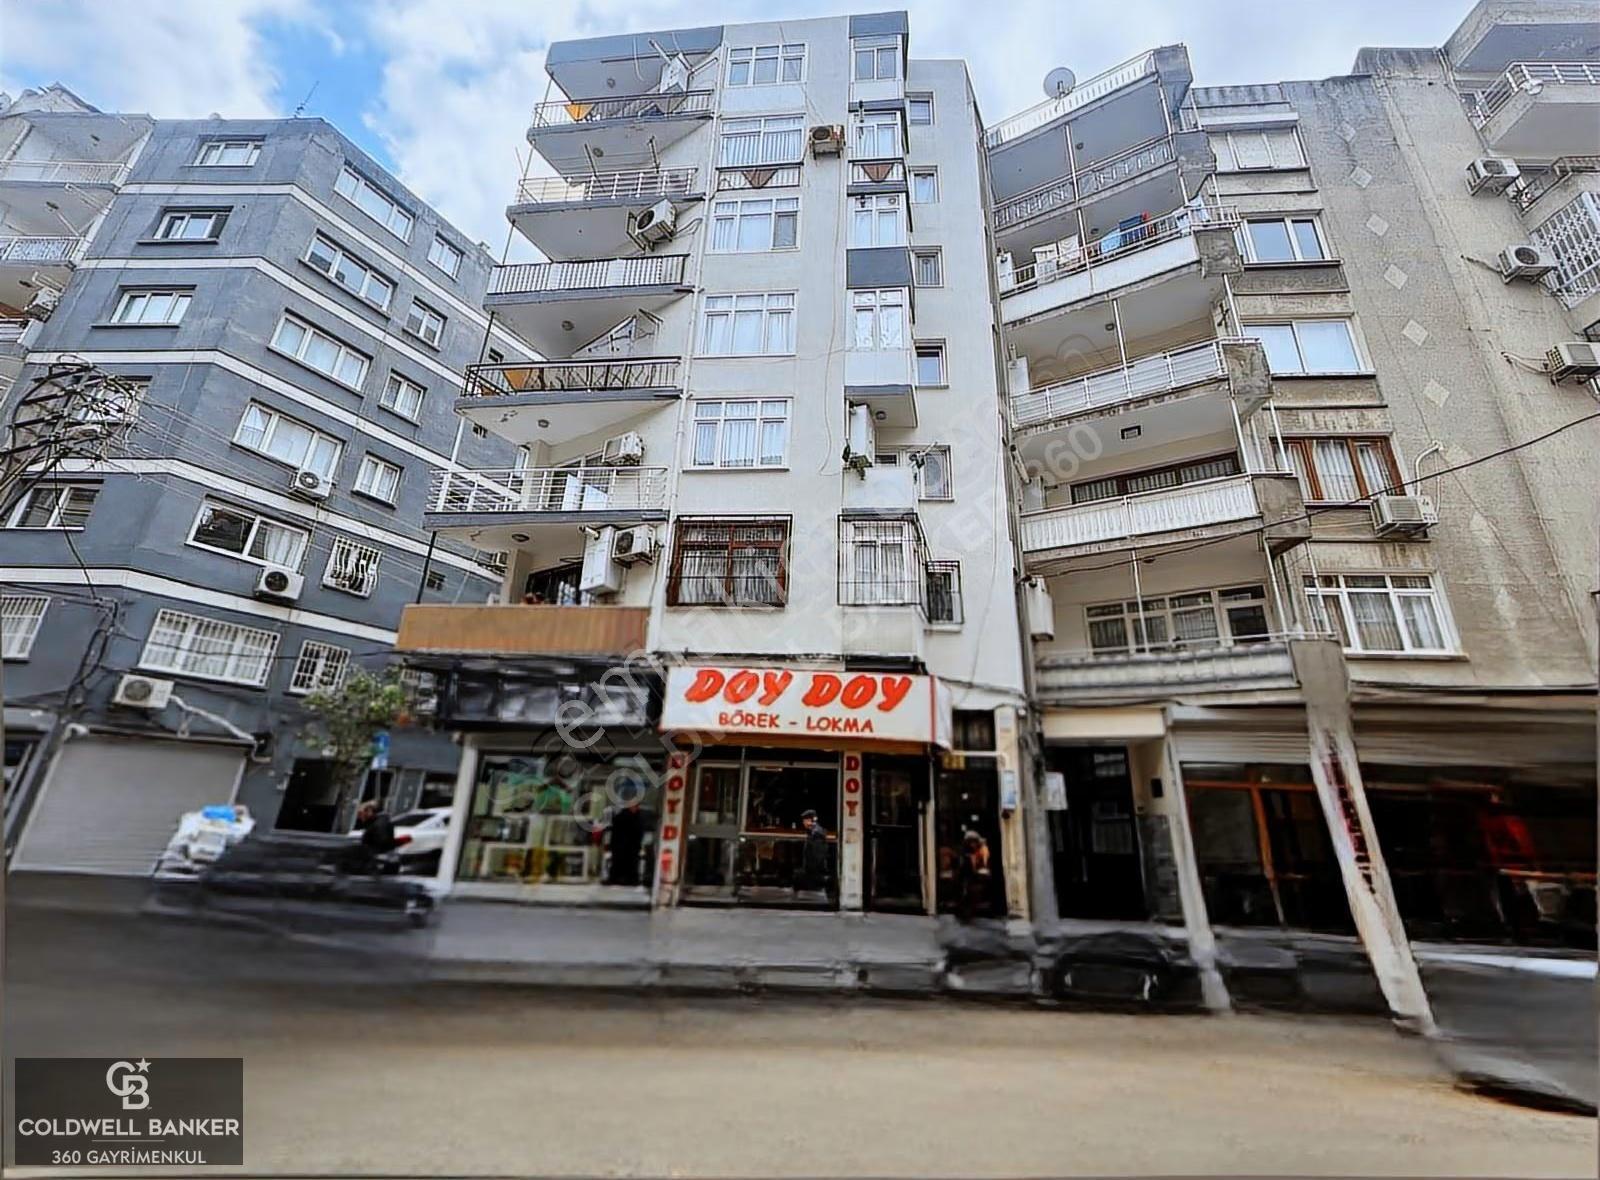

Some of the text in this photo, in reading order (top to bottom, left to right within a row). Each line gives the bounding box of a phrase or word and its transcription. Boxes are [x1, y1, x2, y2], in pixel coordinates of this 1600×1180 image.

[684, 669, 912, 712] DOY DOY
[806, 716, 873, 733] LOKMA
